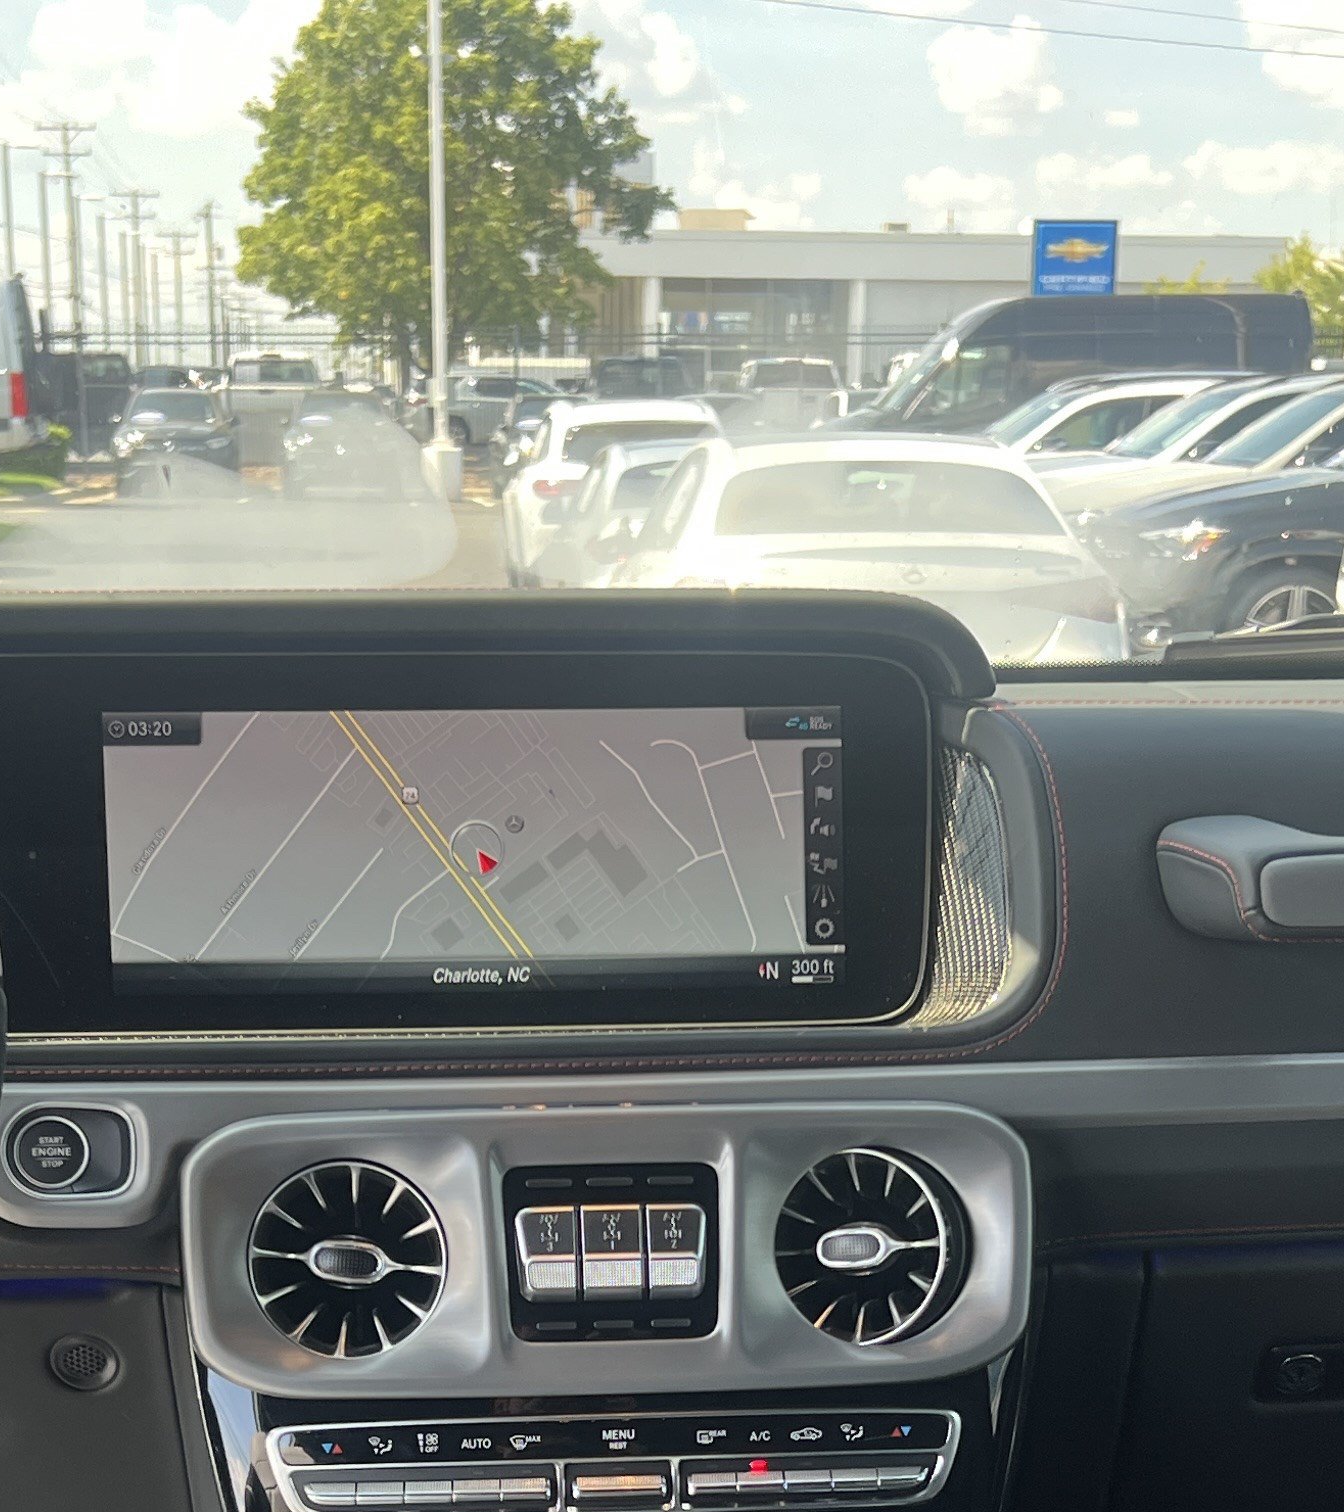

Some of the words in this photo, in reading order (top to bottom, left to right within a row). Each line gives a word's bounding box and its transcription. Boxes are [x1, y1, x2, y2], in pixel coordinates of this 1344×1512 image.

[128, 720, 172, 737] 03:20
[766, 961, 779, 980] N
[792, 959, 819, 974] 300
[823, 959, 834, 974] ft
[433, 967, 503, 985] Charlotte,
[507, 966, 531, 983] NC
[38, 1136, 64, 1144] START
[31, 1147, 72, 1157] ENGINE
[41, 1160, 63, 1168] STOP
[602, 1429, 635, 1440] MENU
[749, 1431, 771, 1442] A/C
[461, 1438, 491, 1449] AUTO
